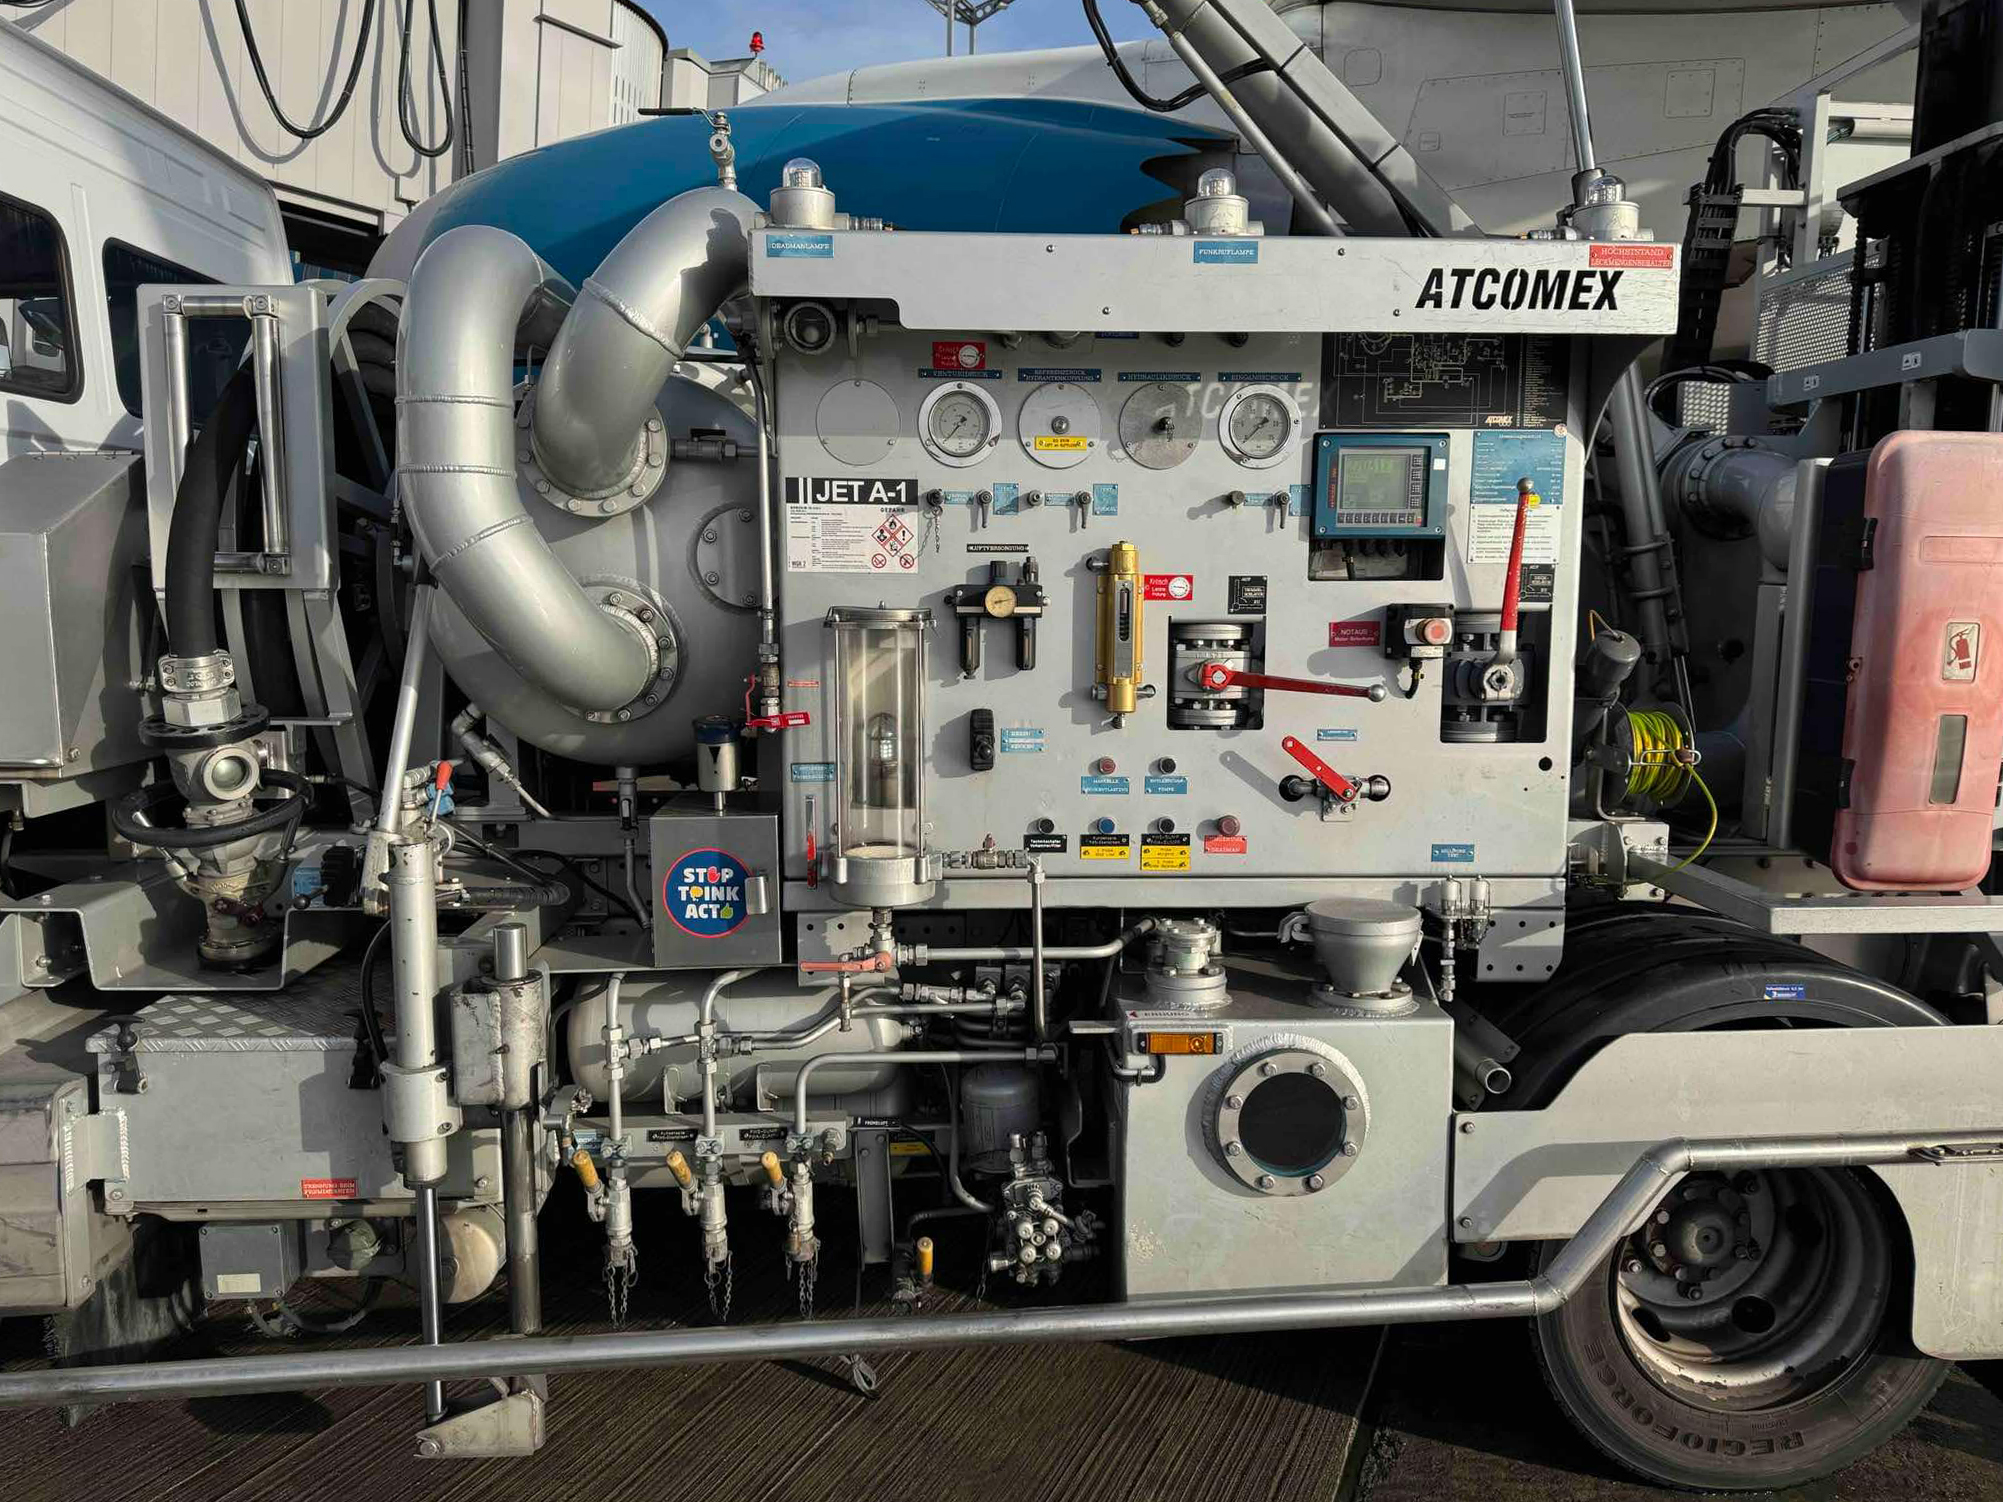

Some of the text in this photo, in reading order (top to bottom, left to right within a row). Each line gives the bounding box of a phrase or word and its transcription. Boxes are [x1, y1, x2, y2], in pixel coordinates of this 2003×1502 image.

[1415, 268, 1624, 311] ATCOMEX
[816, 480, 906, 503] JET A-1
[685, 903, 720, 919] ACT
[1581, 1341, 1806, 1457] REGIOFORCE
